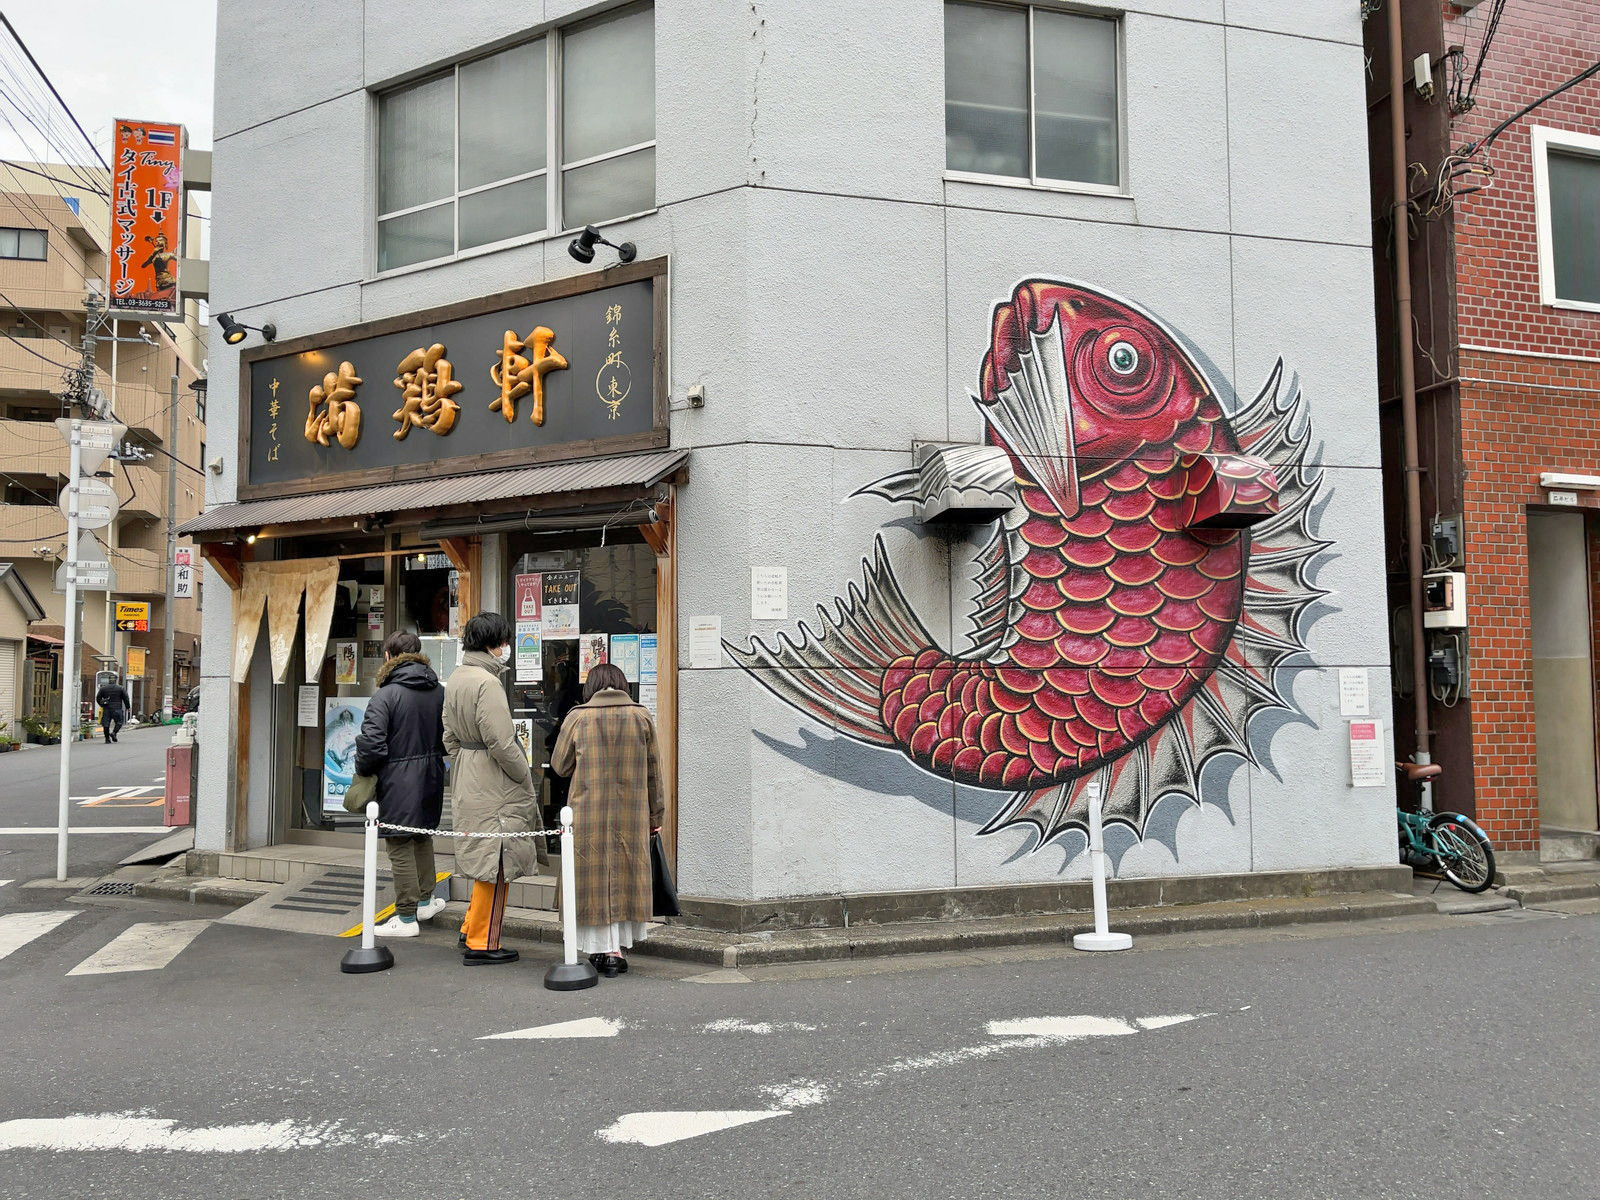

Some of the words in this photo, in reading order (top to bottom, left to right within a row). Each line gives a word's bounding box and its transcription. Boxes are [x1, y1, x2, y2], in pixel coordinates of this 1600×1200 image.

[140, 150, 176, 176] Tiny
[145, 188, 173, 210] 1F
[115, 148, 138, 296] タイ古式マッサージ
[267, 377, 281, 462] 中華そば
[544, 584, 561, 593] TAKE
[564, 583, 577, 592] OUT
[119, 605, 145, 613] Times
